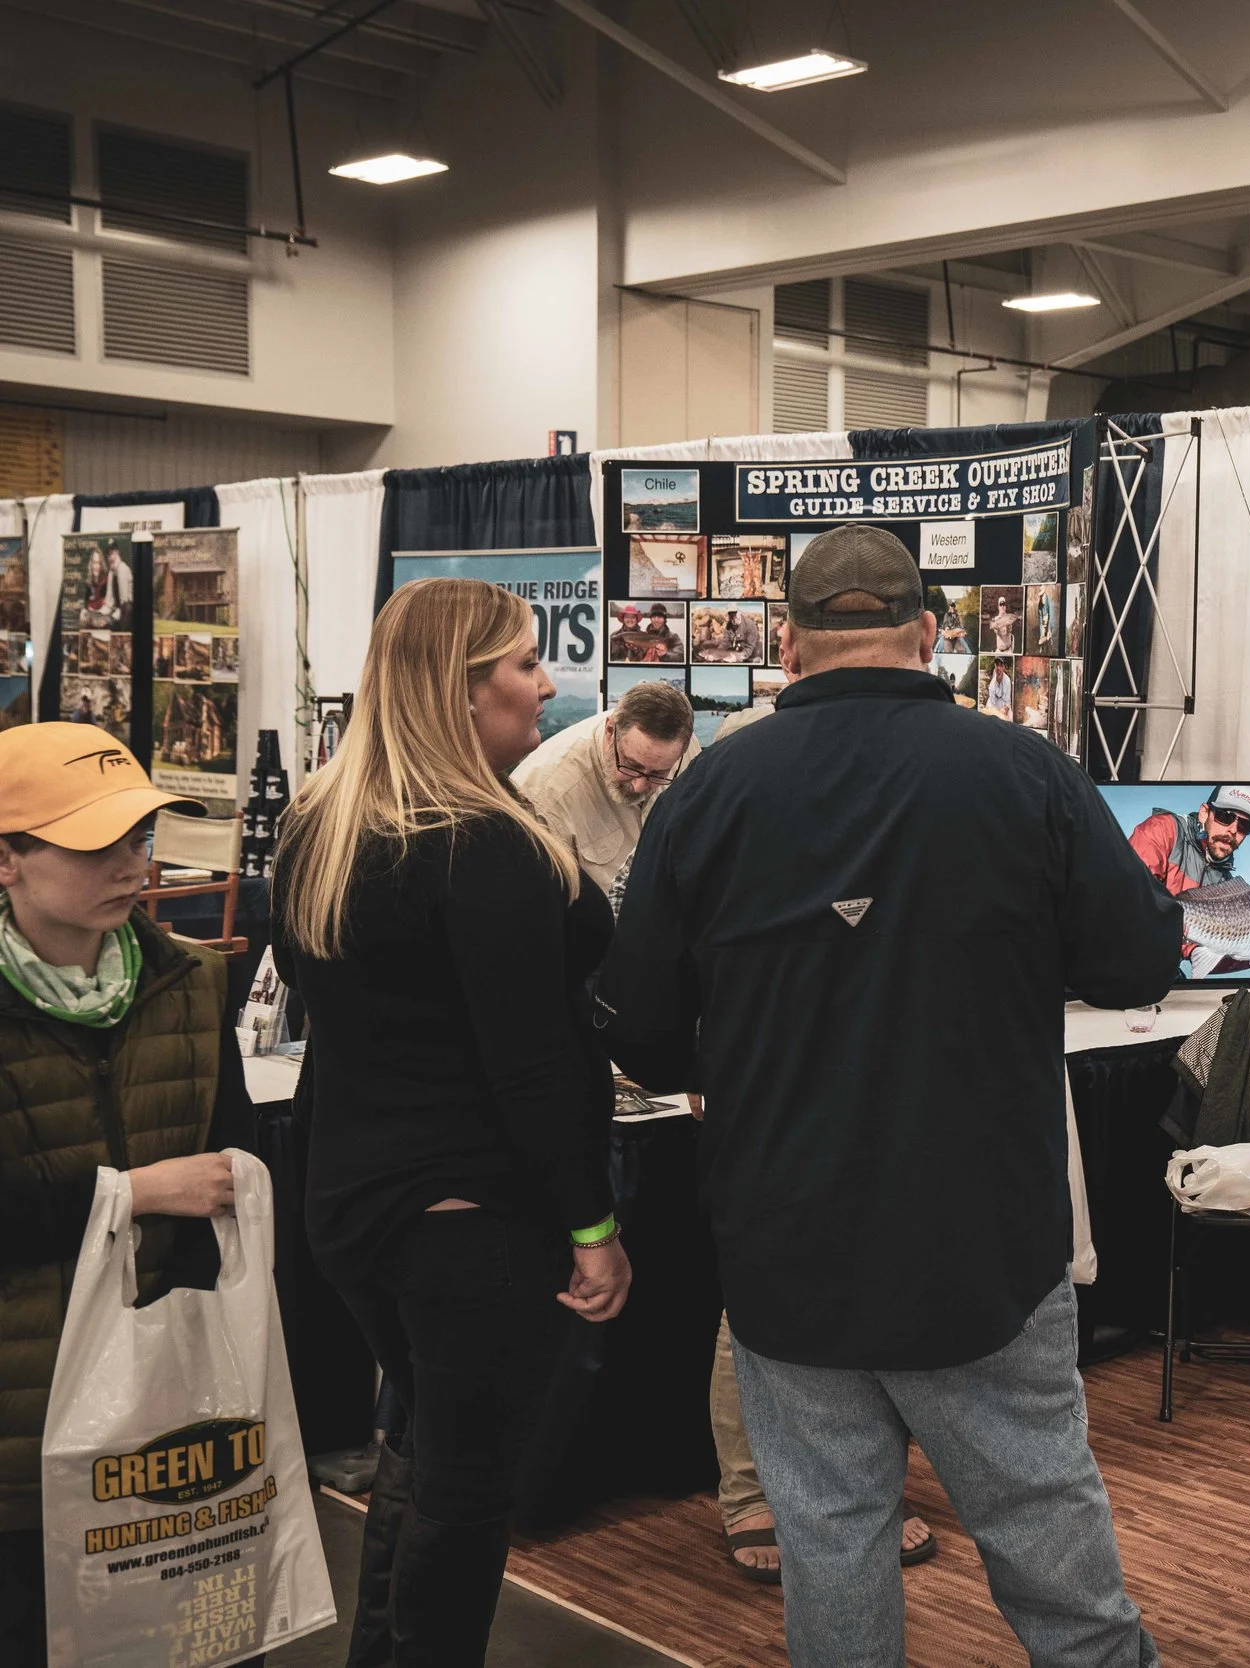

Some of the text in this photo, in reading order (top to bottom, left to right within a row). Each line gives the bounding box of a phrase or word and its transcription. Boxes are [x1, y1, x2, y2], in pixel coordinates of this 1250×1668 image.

[747, 445, 1071, 494] SPRING CREEK OUTFITTERS
[644, 477, 677, 490] Chile
[790, 482, 1056, 516] GUIDE SERVICE & FLY SHOP
[931, 534, 967, 546] Western
[928, 552, 969, 568] Maryland
[543, 581, 598, 600] RIDGE
[92, 1440, 214, 1502] GREEN
[177, 1481, 222, 1499] EST. 1947
[85, 1511, 192, 1555] HUNTING
[194, 1506, 216, 1531] &
